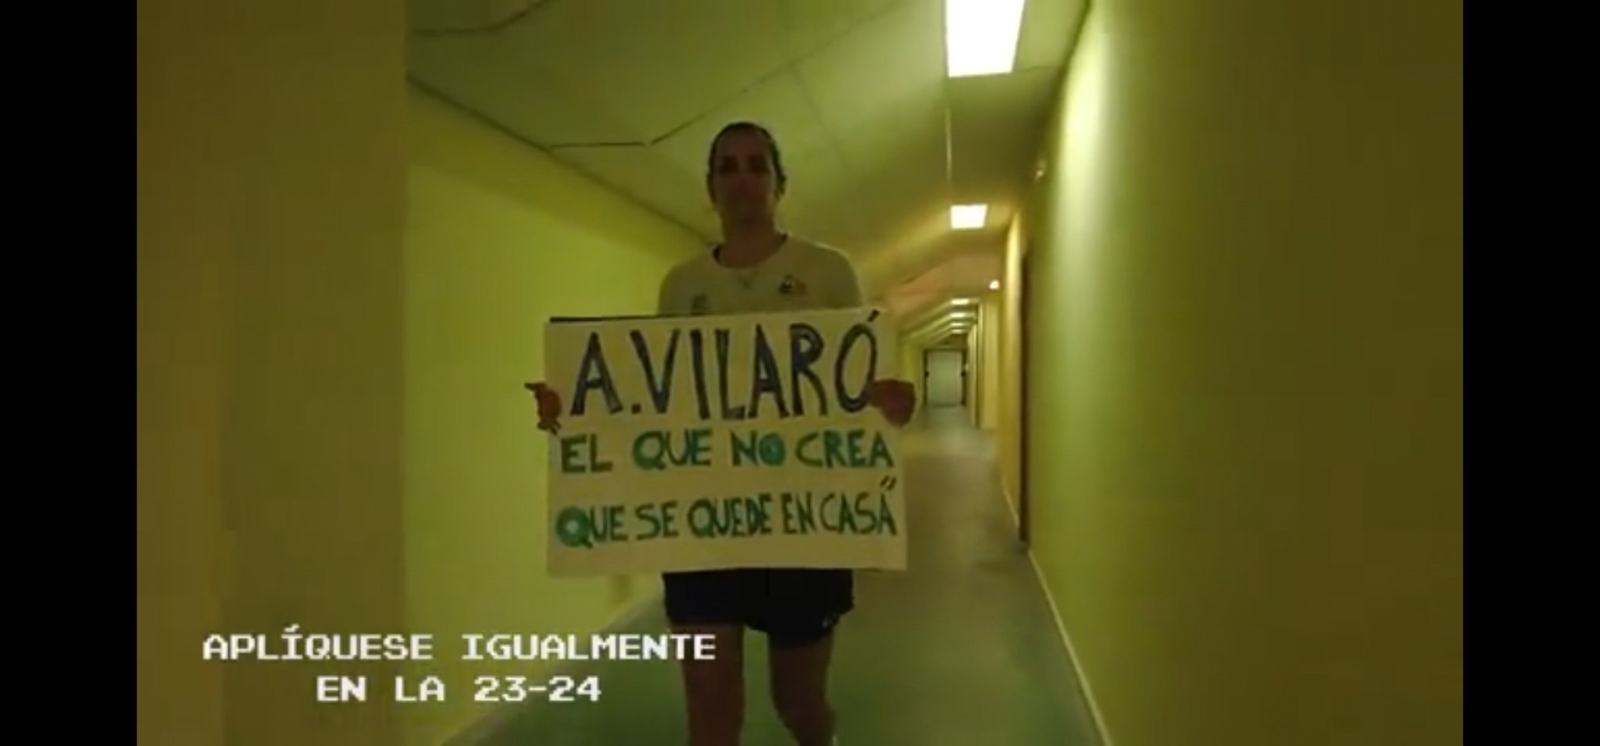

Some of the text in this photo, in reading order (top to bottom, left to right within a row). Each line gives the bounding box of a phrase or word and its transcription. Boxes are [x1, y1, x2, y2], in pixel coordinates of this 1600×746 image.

[570, 310, 879, 420] A.VILARÓ
[560, 429, 894, 474] EL QUE NO CREA
[555, 505, 629, 549] QUE
[636, 500, 679, 541] SE
[687, 493, 772, 538] QUEDE
[782, 492, 817, 536] EN
